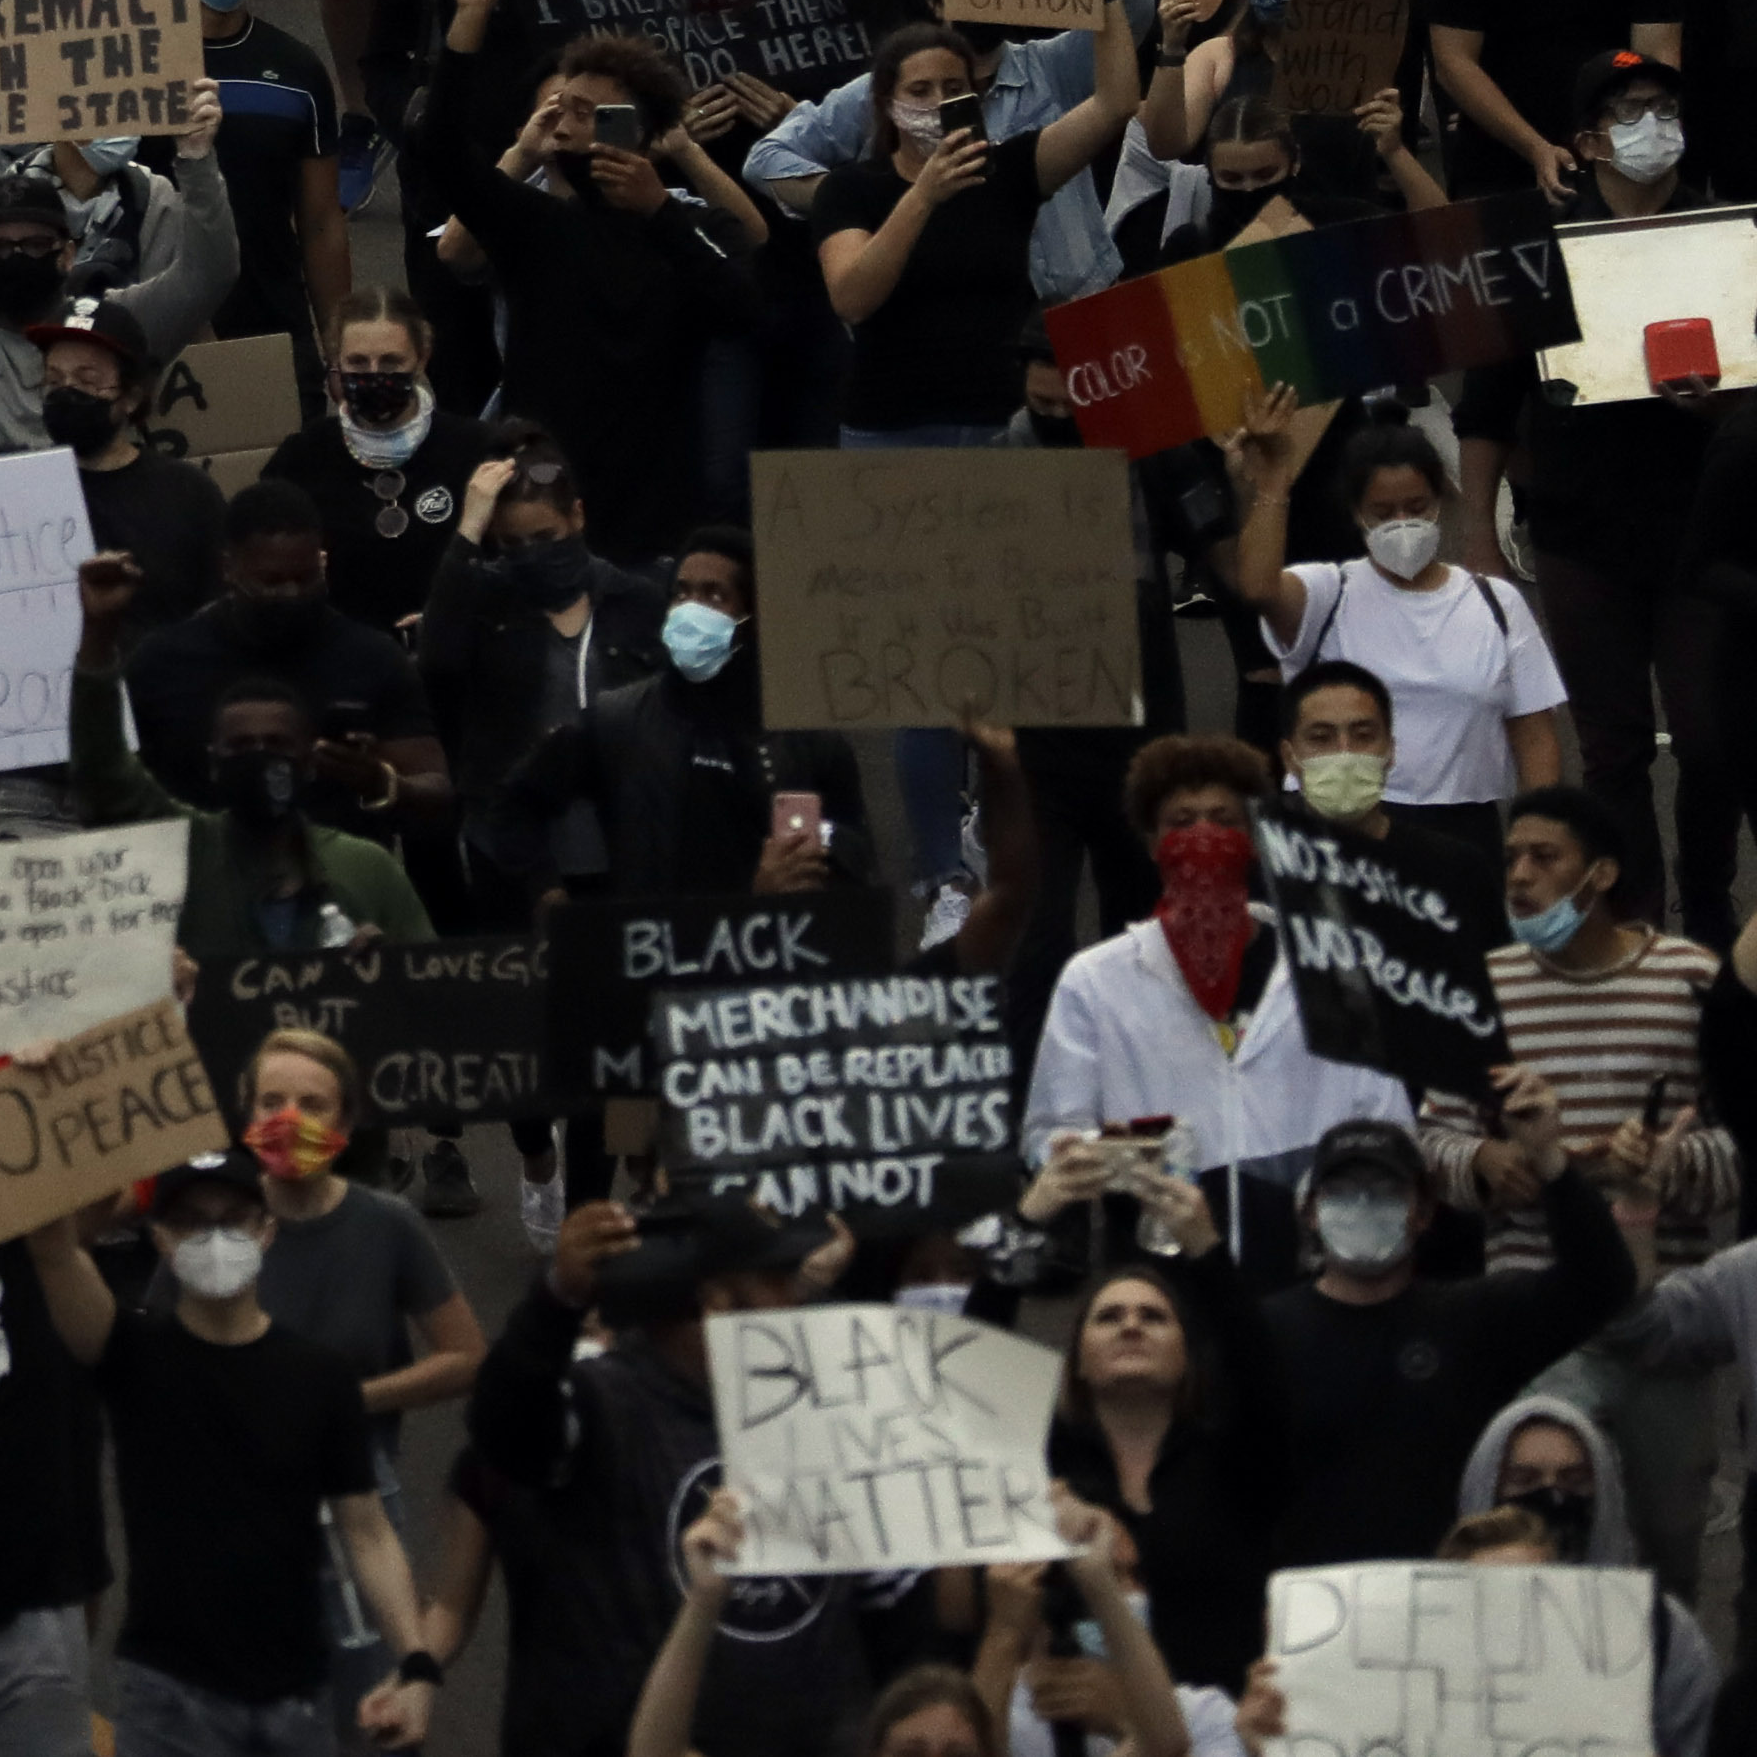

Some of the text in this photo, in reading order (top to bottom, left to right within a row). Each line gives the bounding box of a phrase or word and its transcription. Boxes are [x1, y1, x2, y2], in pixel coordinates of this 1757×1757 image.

[59, 29, 162, 87] THE
[57, 80, 189, 132] STATE
[734, 1315, 997, 1431] BLACK
[739, 1457, 1059, 1564] MATTER
